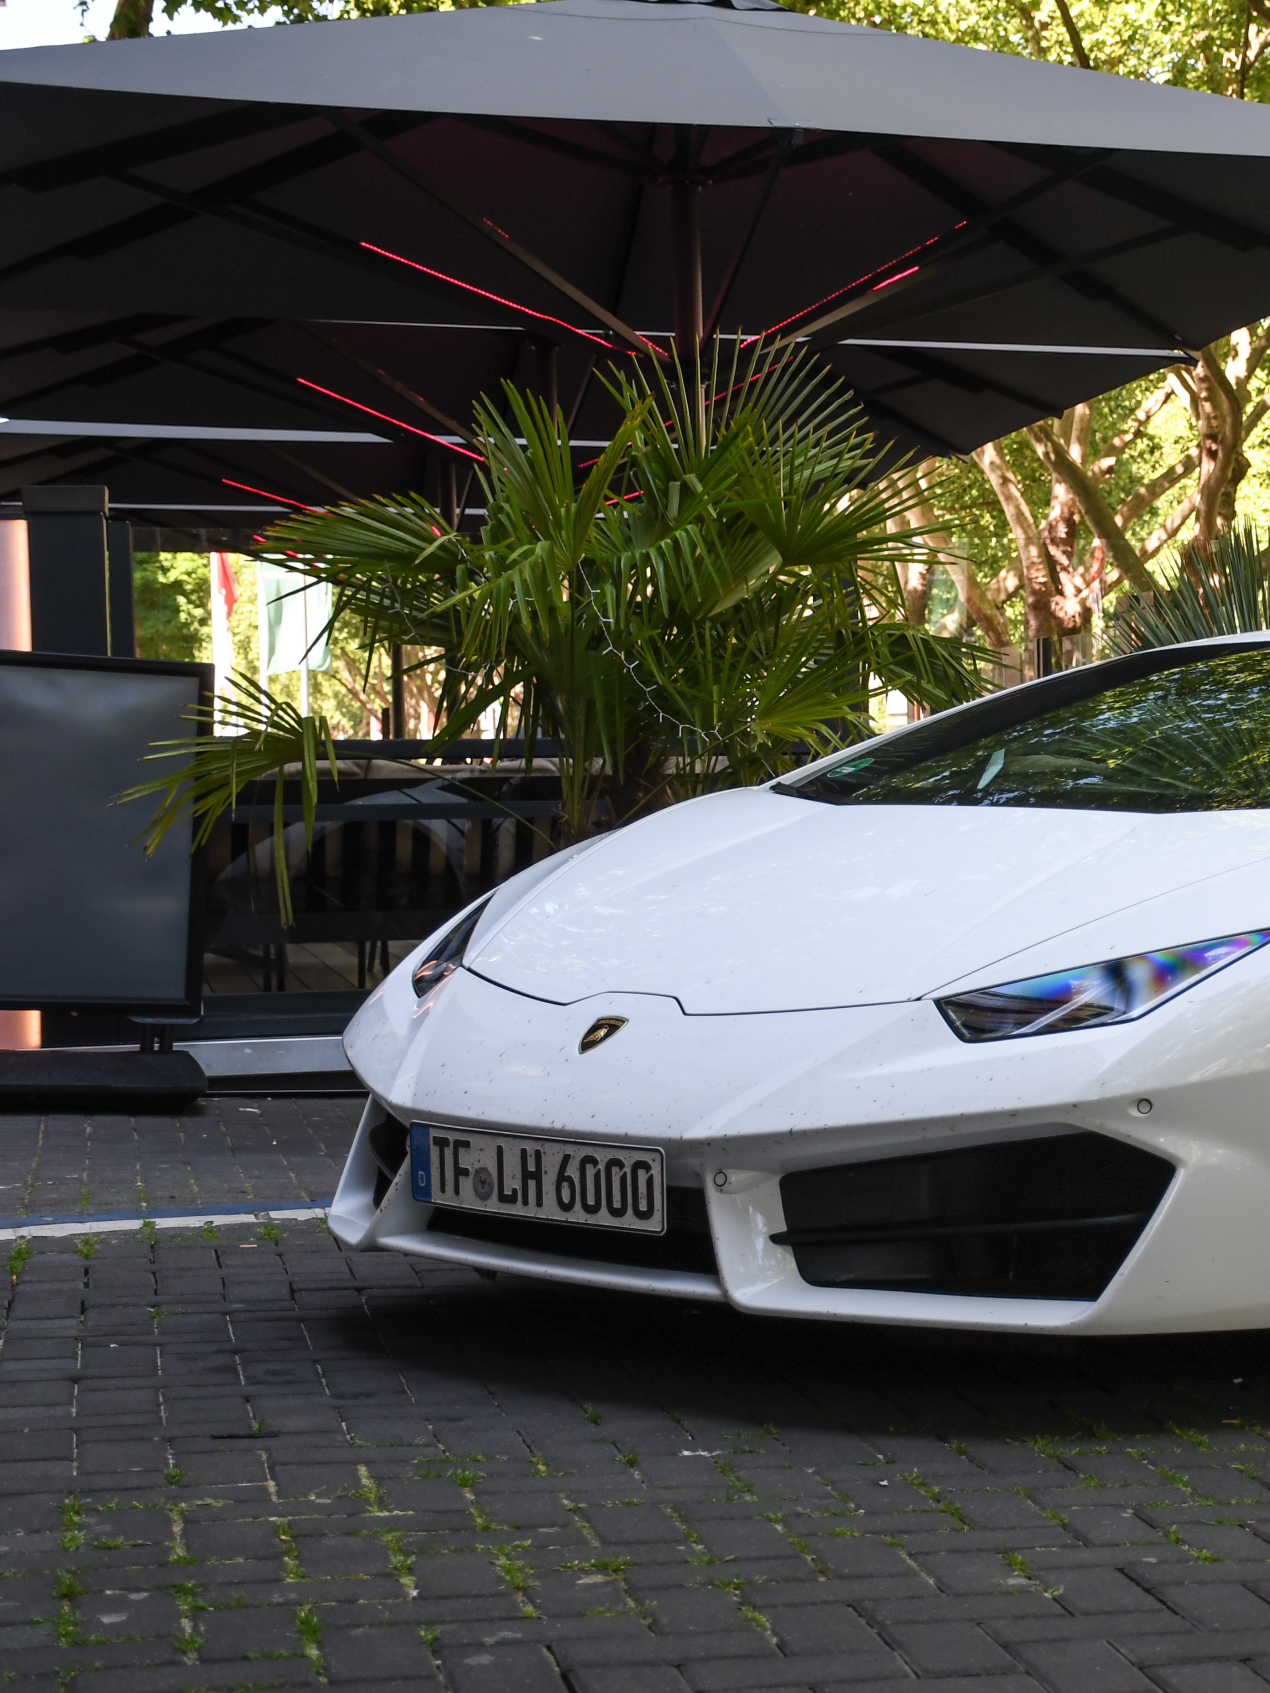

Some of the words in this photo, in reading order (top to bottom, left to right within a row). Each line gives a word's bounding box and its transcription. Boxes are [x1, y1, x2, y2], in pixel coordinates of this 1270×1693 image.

[418, 1170, 426, 1187] D
[432, 1135, 471, 1197] TF
[496, 1144, 543, 1208] LH
[555, 1153, 655, 1221] 6000
